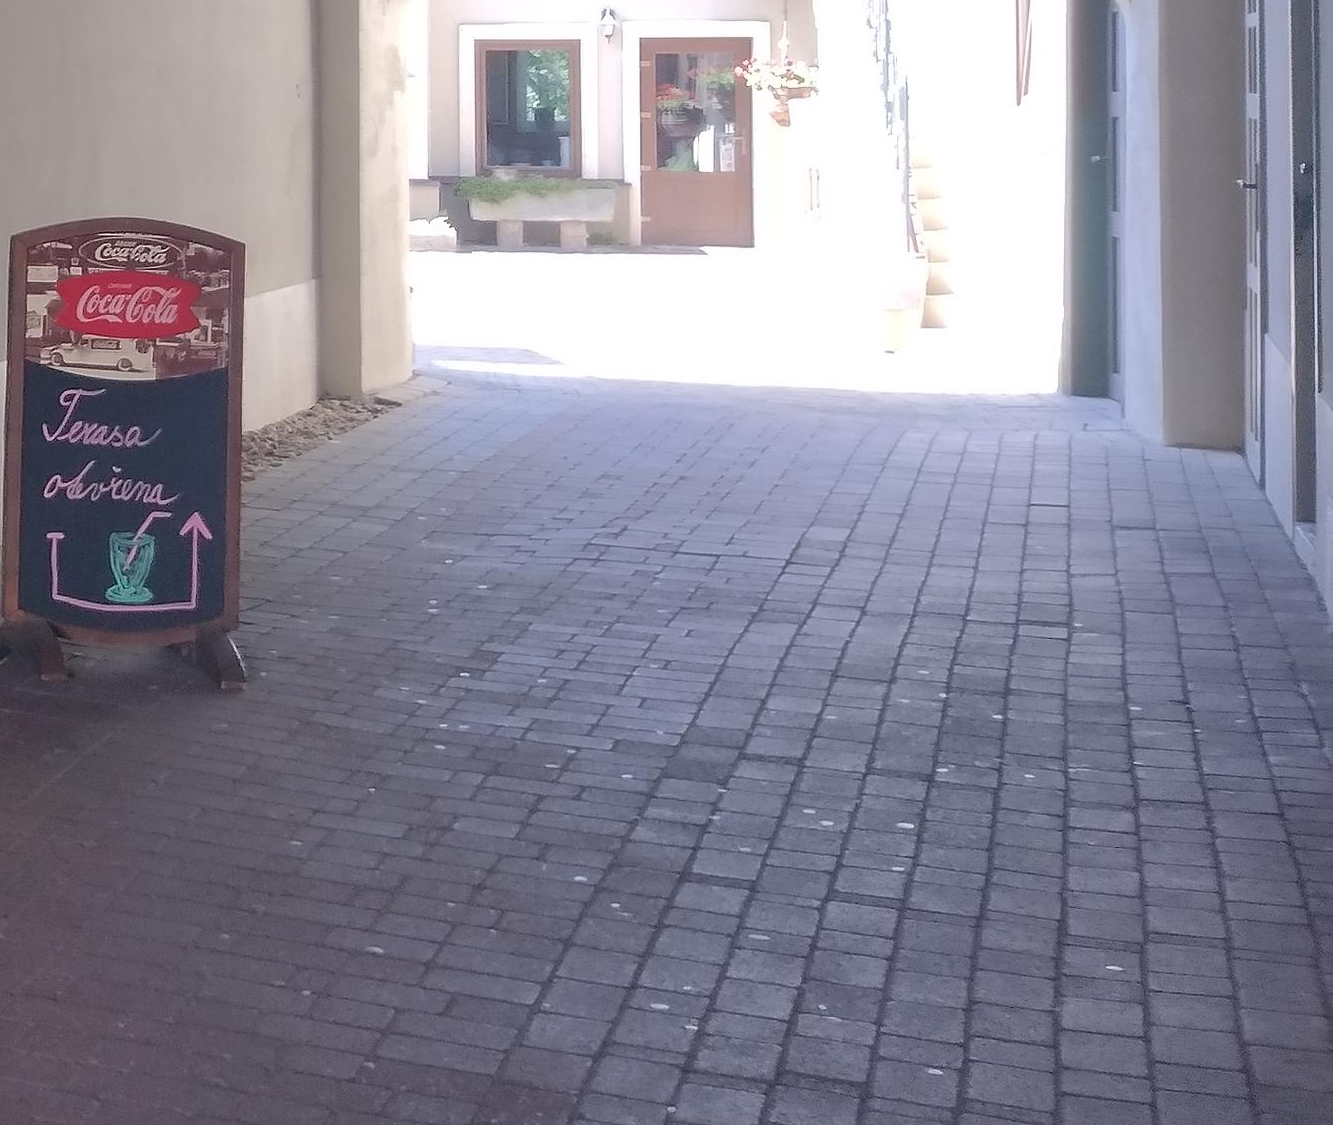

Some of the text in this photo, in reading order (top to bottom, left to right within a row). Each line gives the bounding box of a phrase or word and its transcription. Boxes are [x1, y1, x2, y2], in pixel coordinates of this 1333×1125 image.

[76, 285, 182, 325] Coca-Cola
[42, 389, 162, 447] Terasa
[43, 460, 180, 506] otevřena
